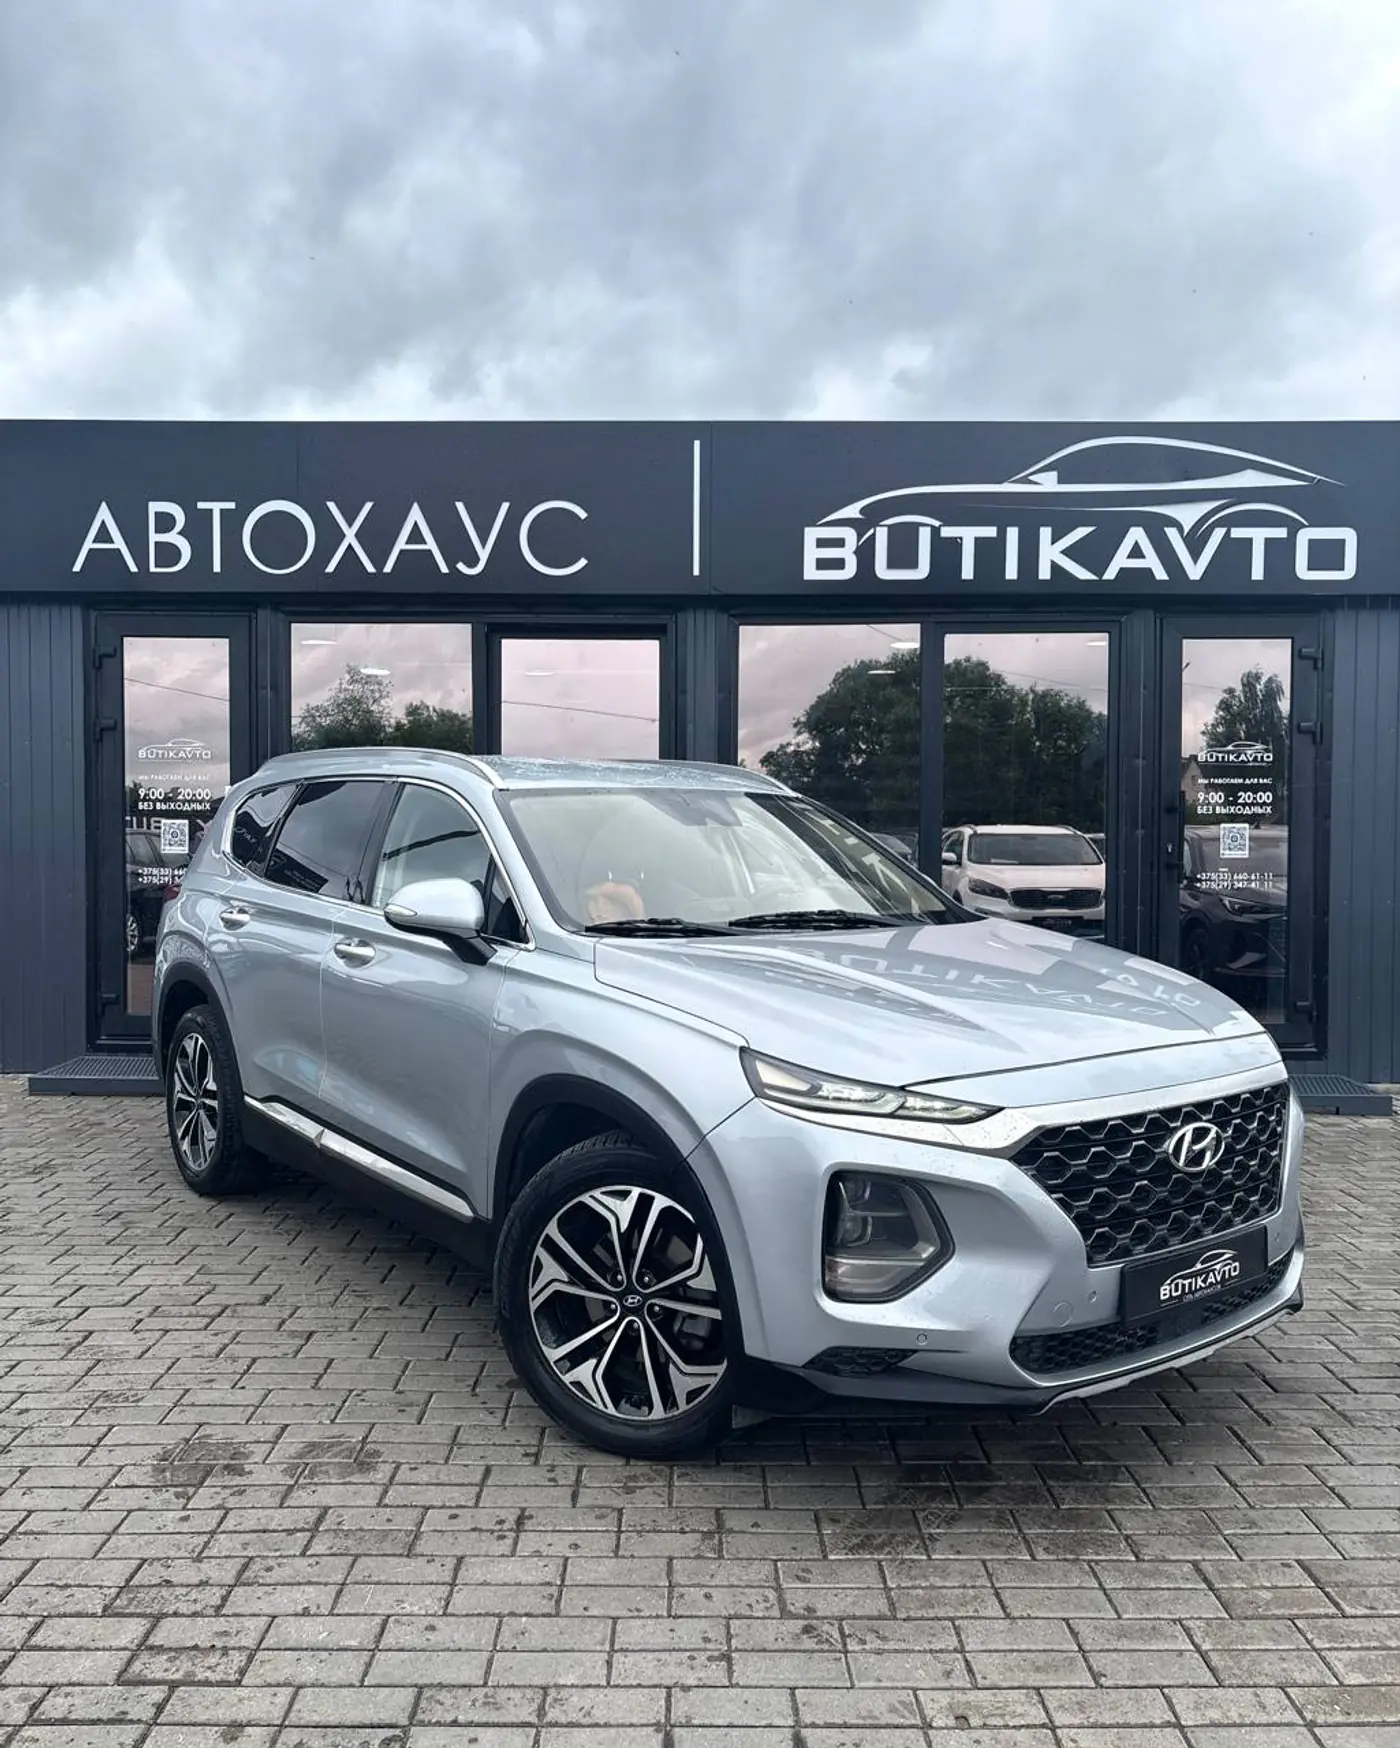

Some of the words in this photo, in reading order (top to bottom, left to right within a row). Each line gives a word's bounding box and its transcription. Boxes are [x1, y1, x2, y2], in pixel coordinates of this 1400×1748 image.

[72, 500, 589, 576] АВТОХАУС
[803, 526, 1358, 581] BUTIKAVTO
[138, 749, 212, 759] BUTIKAVTO
[1198, 752, 1273, 762] BUTIKAVTO
[138, 788, 165, 800] 9:00
[177, 788, 212, 800] 20:00
[1197, 791, 1225, 804] 9:00
[1237, 791, 1273, 804] 20:00
[138, 801, 154, 810] БЕЗ
[155, 801, 211, 811] ВЫХОДНЫХ
[1197, 805, 1213, 814] БЕЗ
[1215, 805, 1272, 815] ВЫХОДНЫХ
[1196, 872, 1231, 881] +375(33)
[1233, 881, 1273, 890] 347-4111
[1160, 1262, 1240, 1300] BUTIKAVTO
